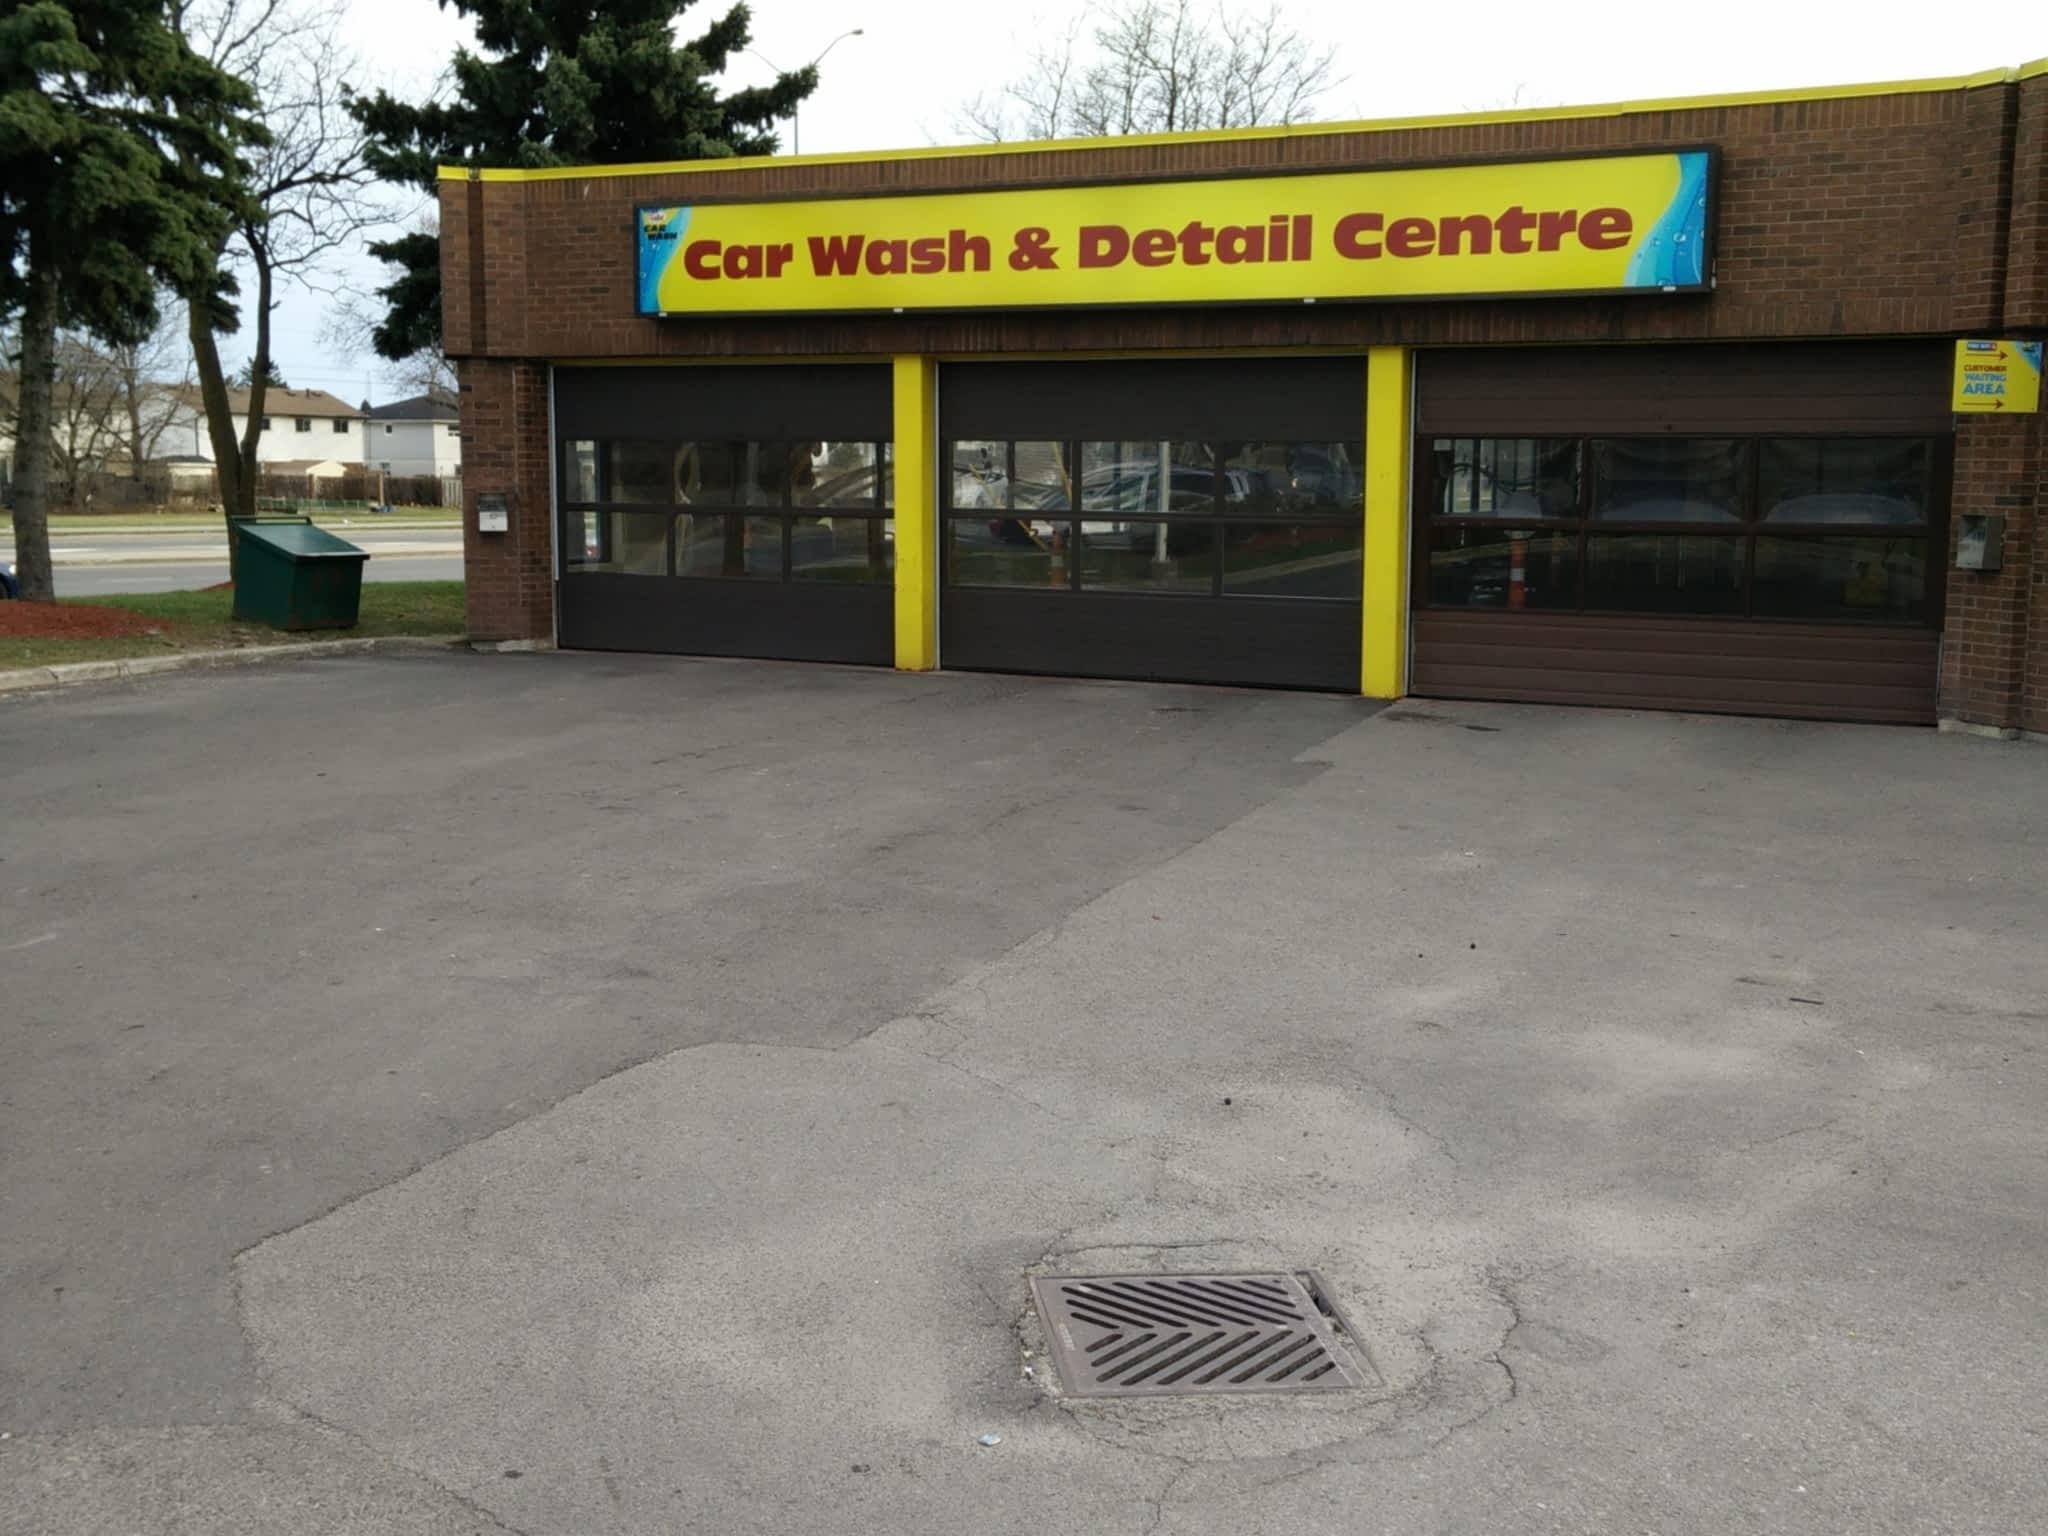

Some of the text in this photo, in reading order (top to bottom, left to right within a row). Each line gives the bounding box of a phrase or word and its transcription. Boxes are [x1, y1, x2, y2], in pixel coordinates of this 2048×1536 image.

[683, 206, 1633, 281] Car Wash & Detail Centre
[1963, 364, 2007, 372] CUSTOMER
[1964, 373, 2007, 382] WAITING
[1963, 383, 2005, 394] AREA
